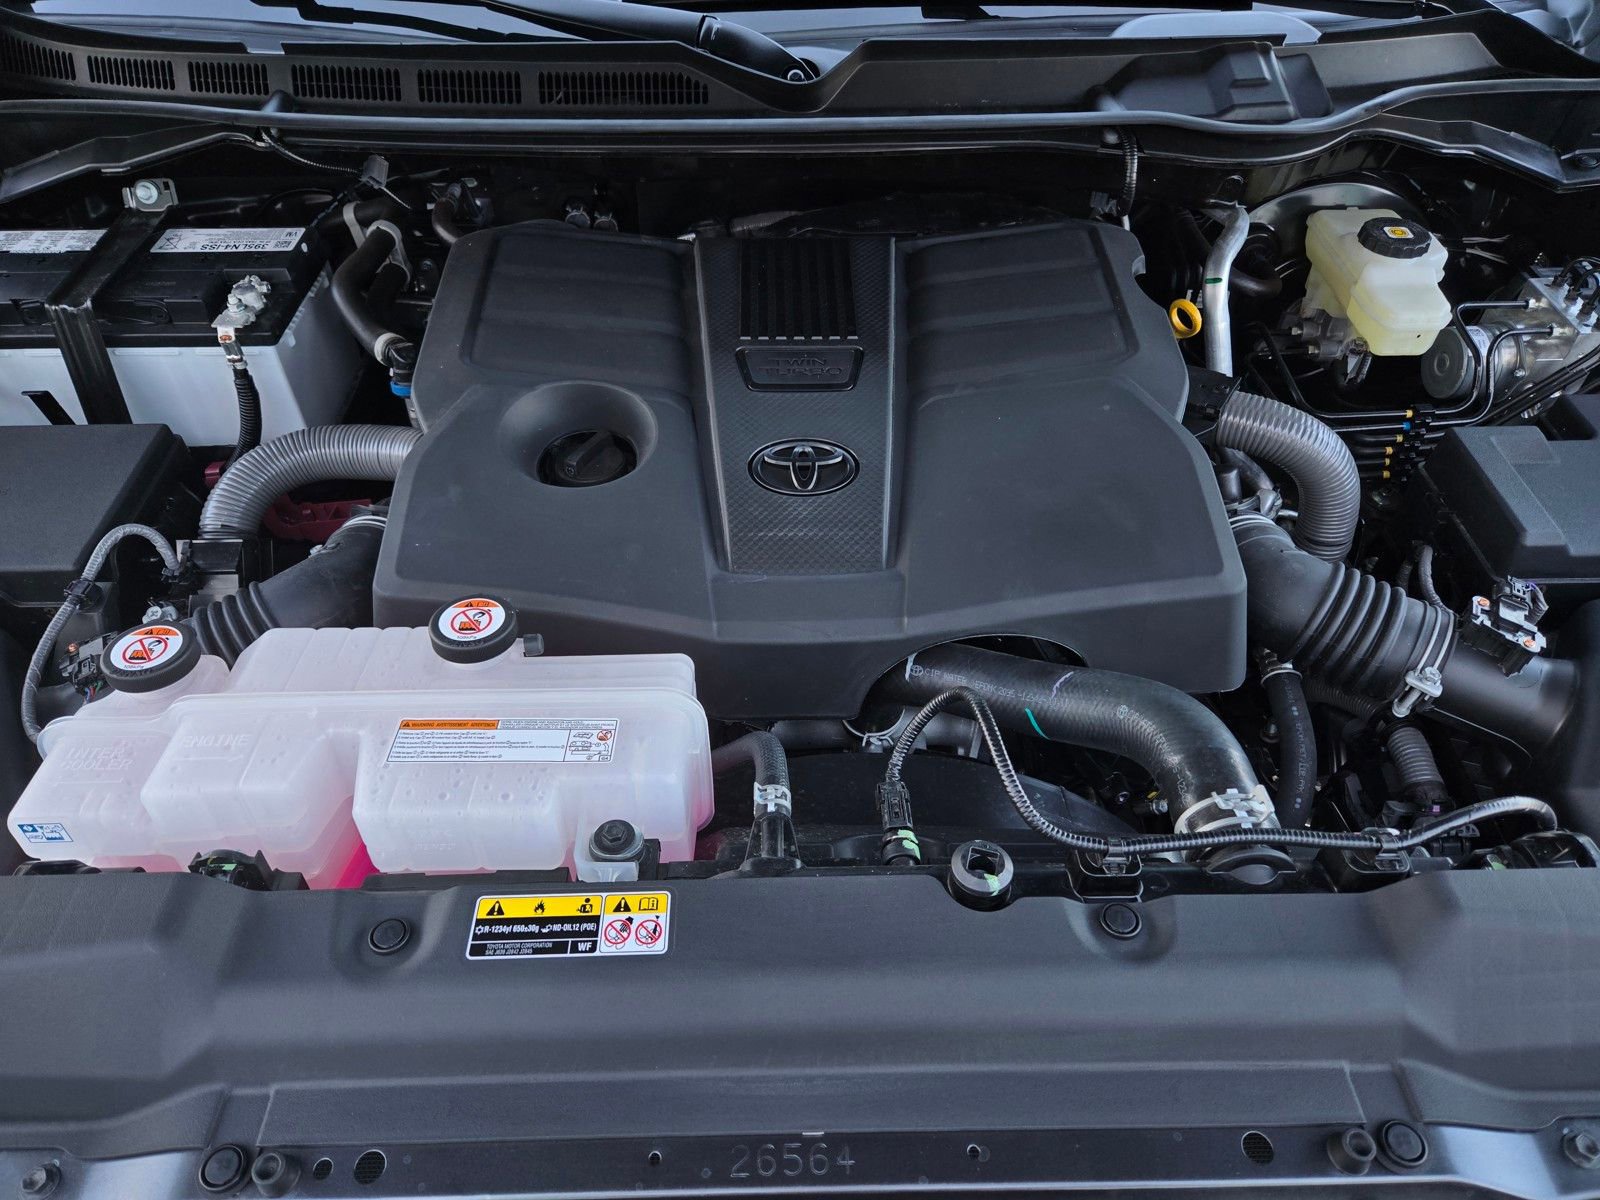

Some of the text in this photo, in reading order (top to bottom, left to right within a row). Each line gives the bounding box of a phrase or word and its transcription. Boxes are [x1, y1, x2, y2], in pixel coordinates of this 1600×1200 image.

[768, 358, 827, 367] TWIN
[180, 735, 251, 747] ENGINE
[66, 746, 130, 759] INTER
[60, 758, 135, 770] COOLER
[483, 925, 512, 934] R-1234yf
[512, 924, 540, 934] 650±30g
[580, 922, 597, 932] (POE)
[577, 942, 592, 951] WF
[730, 1142, 856, 1177] 26564
